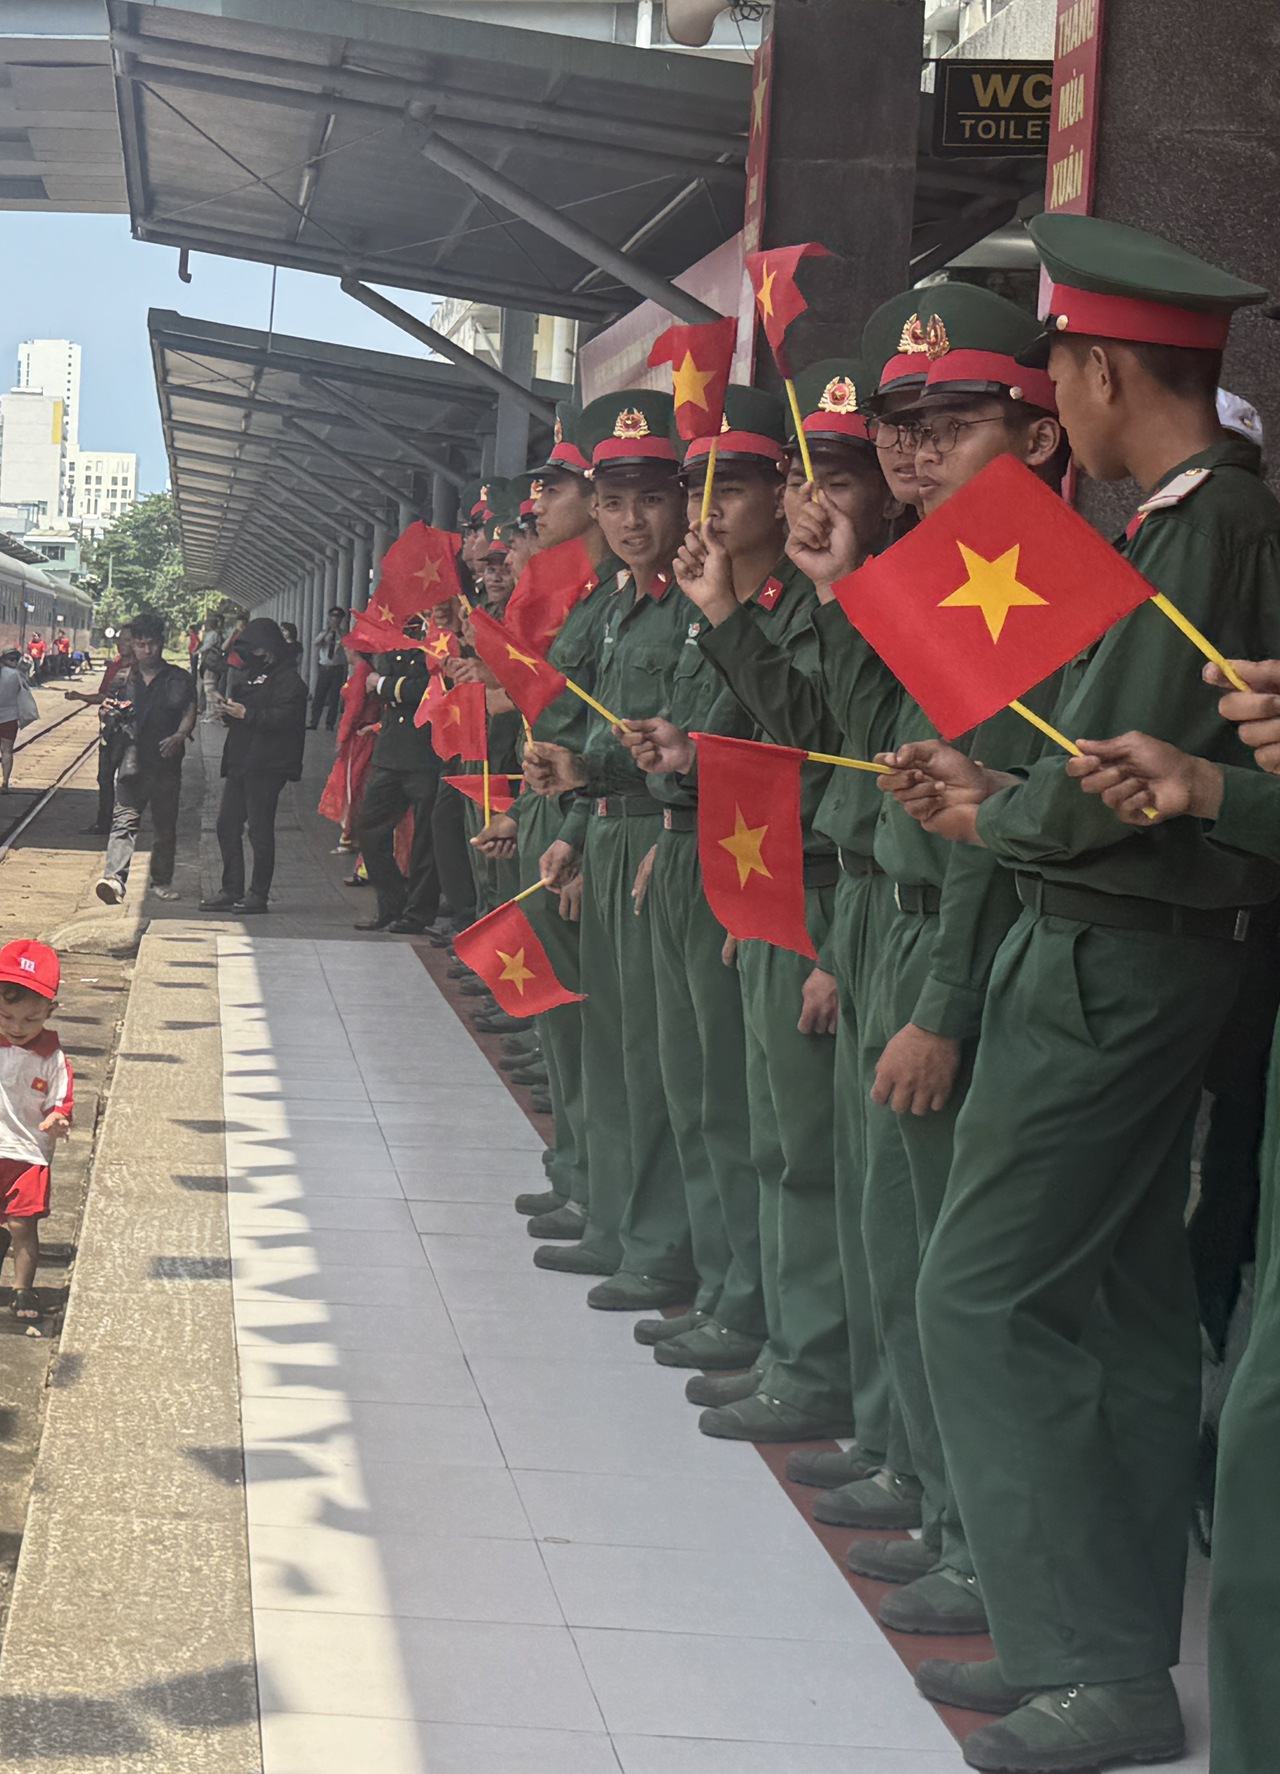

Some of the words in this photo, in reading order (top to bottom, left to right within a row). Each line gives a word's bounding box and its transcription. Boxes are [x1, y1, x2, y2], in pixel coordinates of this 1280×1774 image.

[972, 74, 1053, 109] WC
[1058, 69, 1084, 132] MÙA
[960, 119, 1052, 139] TOILE
[1050, 144, 1084, 210] XUÂN
